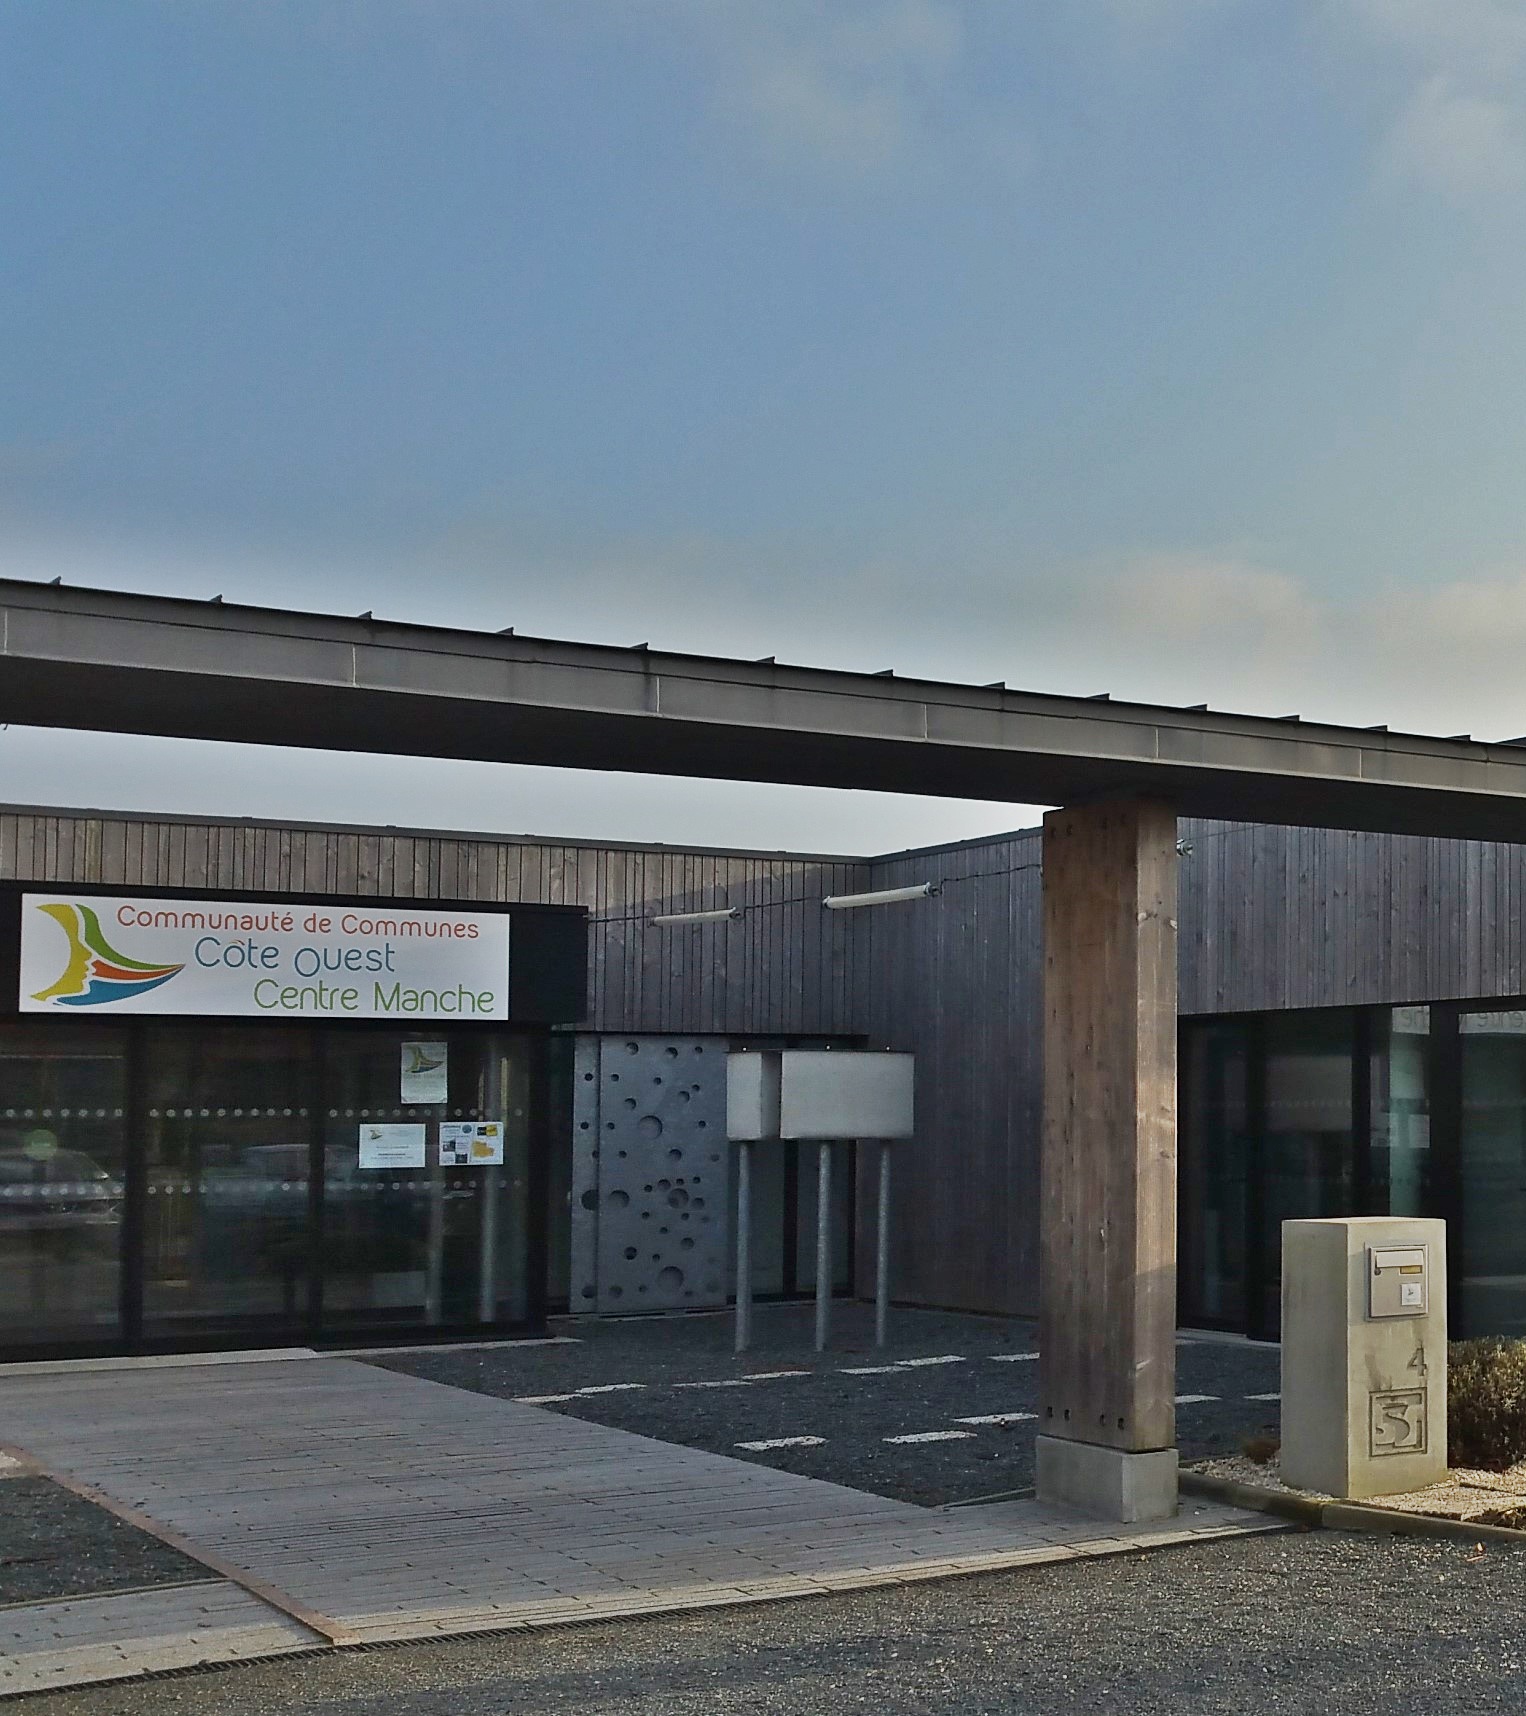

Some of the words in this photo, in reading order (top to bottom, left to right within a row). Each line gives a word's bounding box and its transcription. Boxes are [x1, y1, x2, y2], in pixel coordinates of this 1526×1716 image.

[117, 904, 294, 933] Communauté
[303, 912, 332, 934] de
[341, 914, 480, 939] Communes
[194, 936, 280, 970] Côte
[294, 942, 396, 978] Ouest
[253, 978, 359, 1012] Centre
[374, 981, 496, 1014] Manche
[1407, 1347, 1427, 1377] 4
